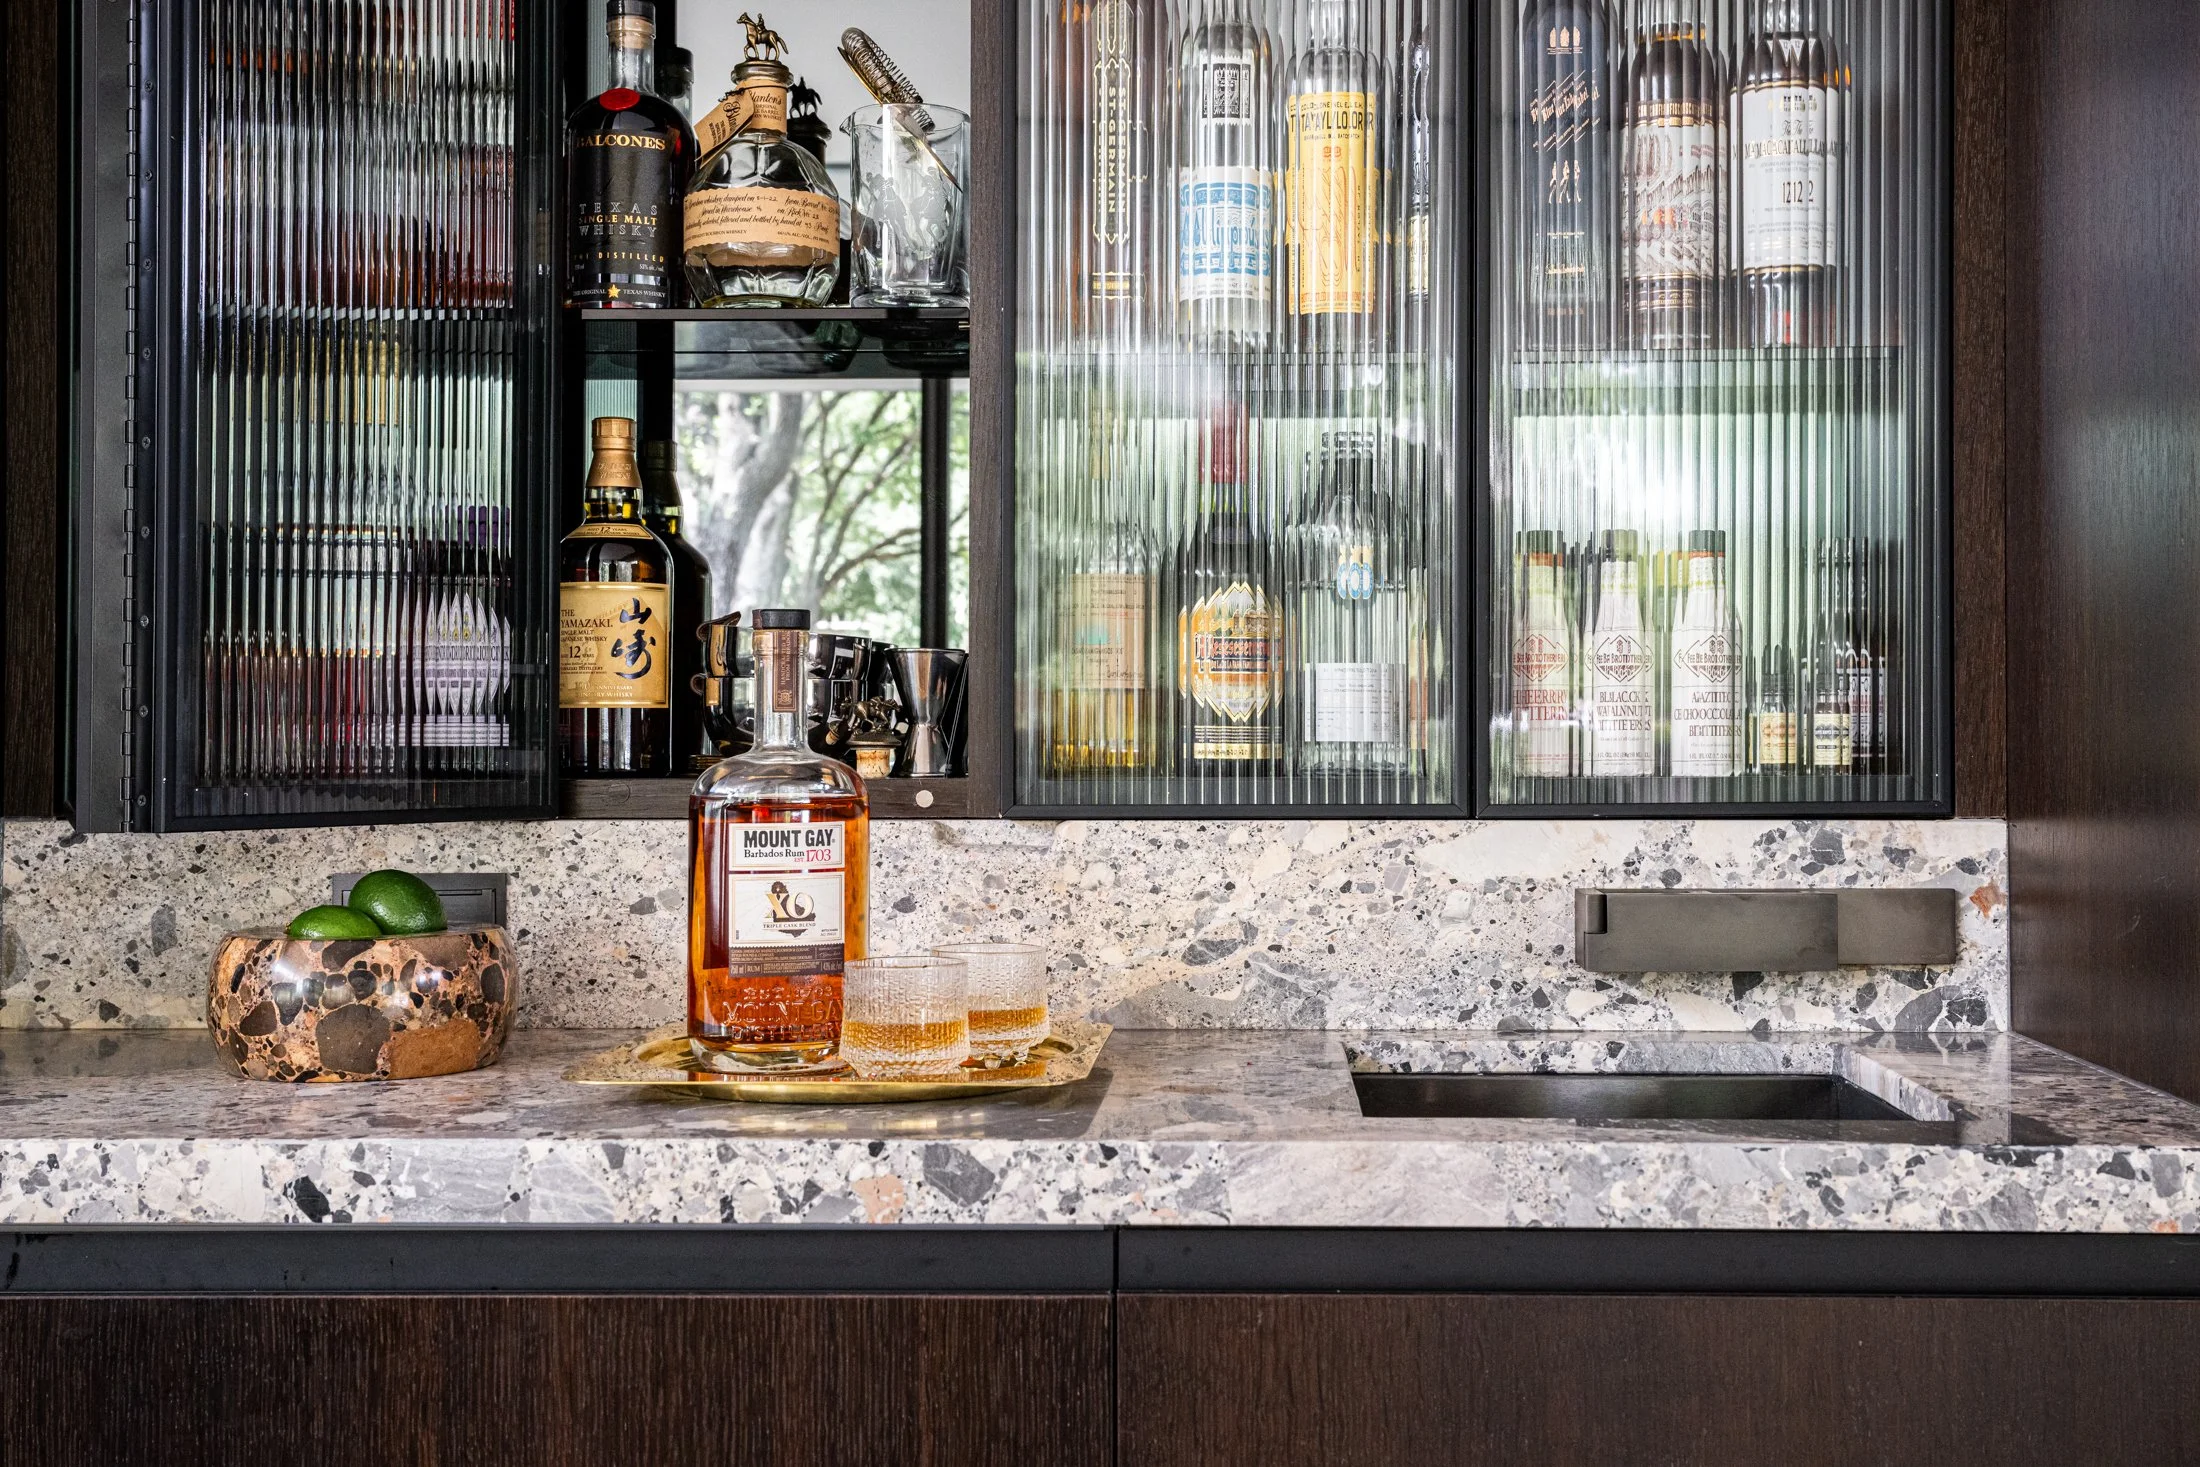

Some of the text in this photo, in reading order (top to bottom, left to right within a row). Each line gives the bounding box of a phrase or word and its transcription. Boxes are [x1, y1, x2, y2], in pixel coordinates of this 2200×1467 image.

[579, 201, 658, 216] TEXAS
[579, 215, 658, 226] SINGLE MALT
[579, 224, 657, 238] WHISKY
[598, 251, 664, 263] DISTILLED
[643, 290, 666, 298] WHISKY
[561, 609, 575, 617] THE
[561, 618, 611, 628] YAMAZAKI
[569, 645, 581, 659] 12
[743, 828, 834, 849] MOUNT GAY
[744, 848, 805, 858] Barbados Rum
[805, 848, 832, 862] 1703
[764, 891, 815, 919] XO
[747, 964, 760, 973] RUM
[722, 1001, 805, 1025] MOUNT
